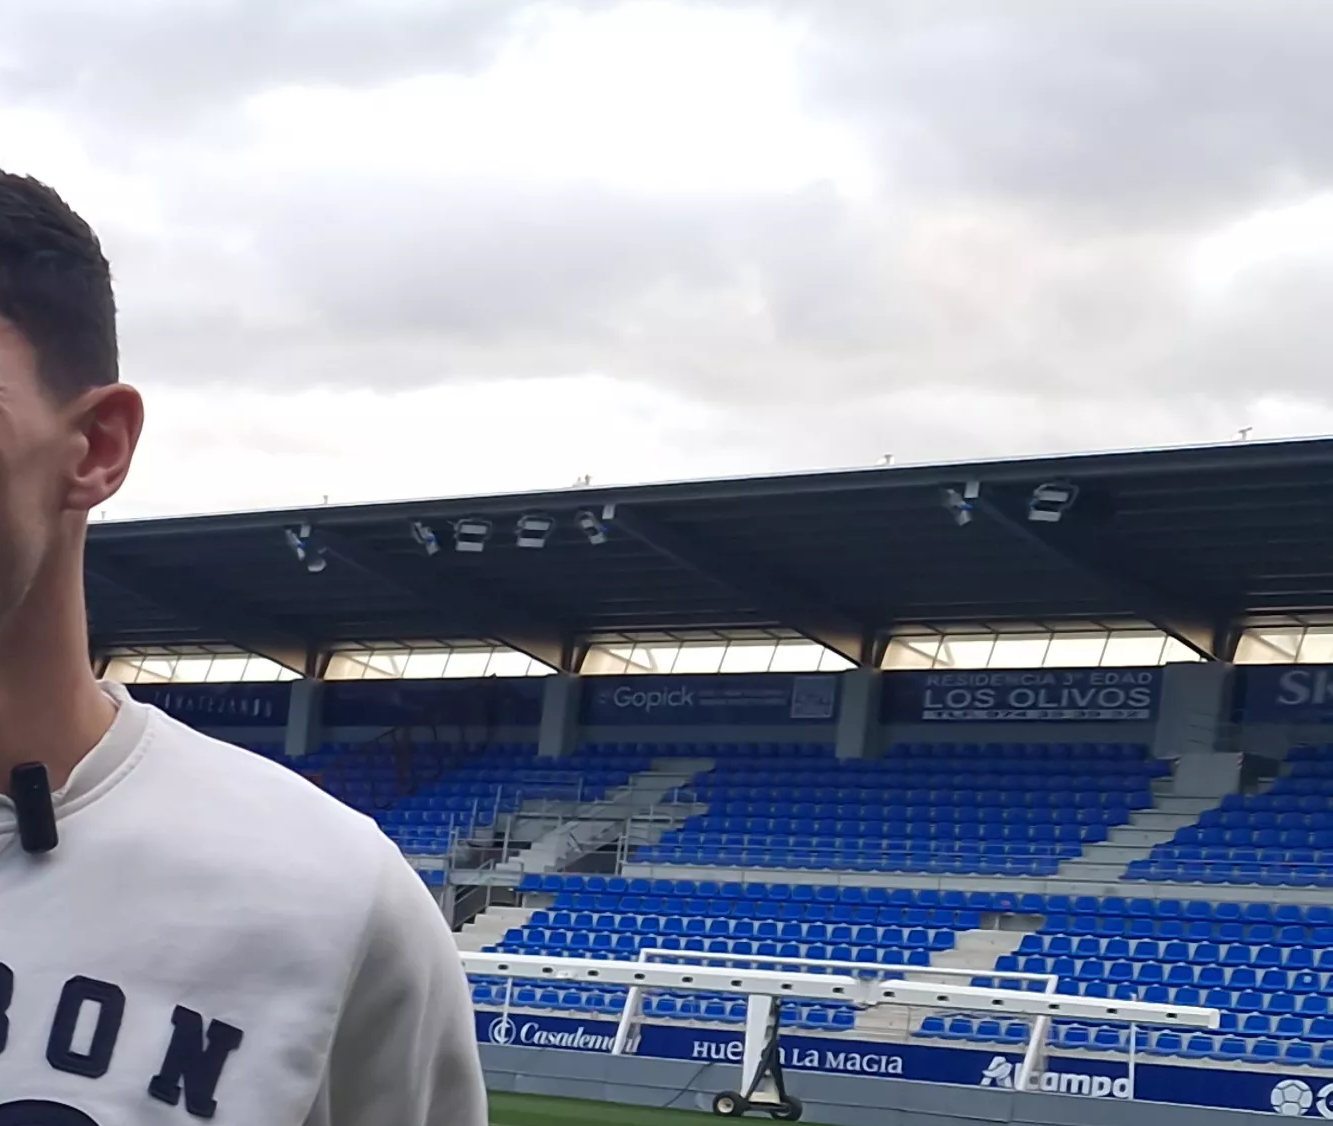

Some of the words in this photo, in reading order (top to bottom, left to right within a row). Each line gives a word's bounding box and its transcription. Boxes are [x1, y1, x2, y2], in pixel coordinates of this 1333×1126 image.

[926, 672, 1056, 688] RESIDENCIA
[1089, 671, 1153, 686] EDAD
[613, 685, 694, 713] Gopick
[923, 688, 996, 709] LOS
[1009, 687, 1152, 708] OLIVOS
